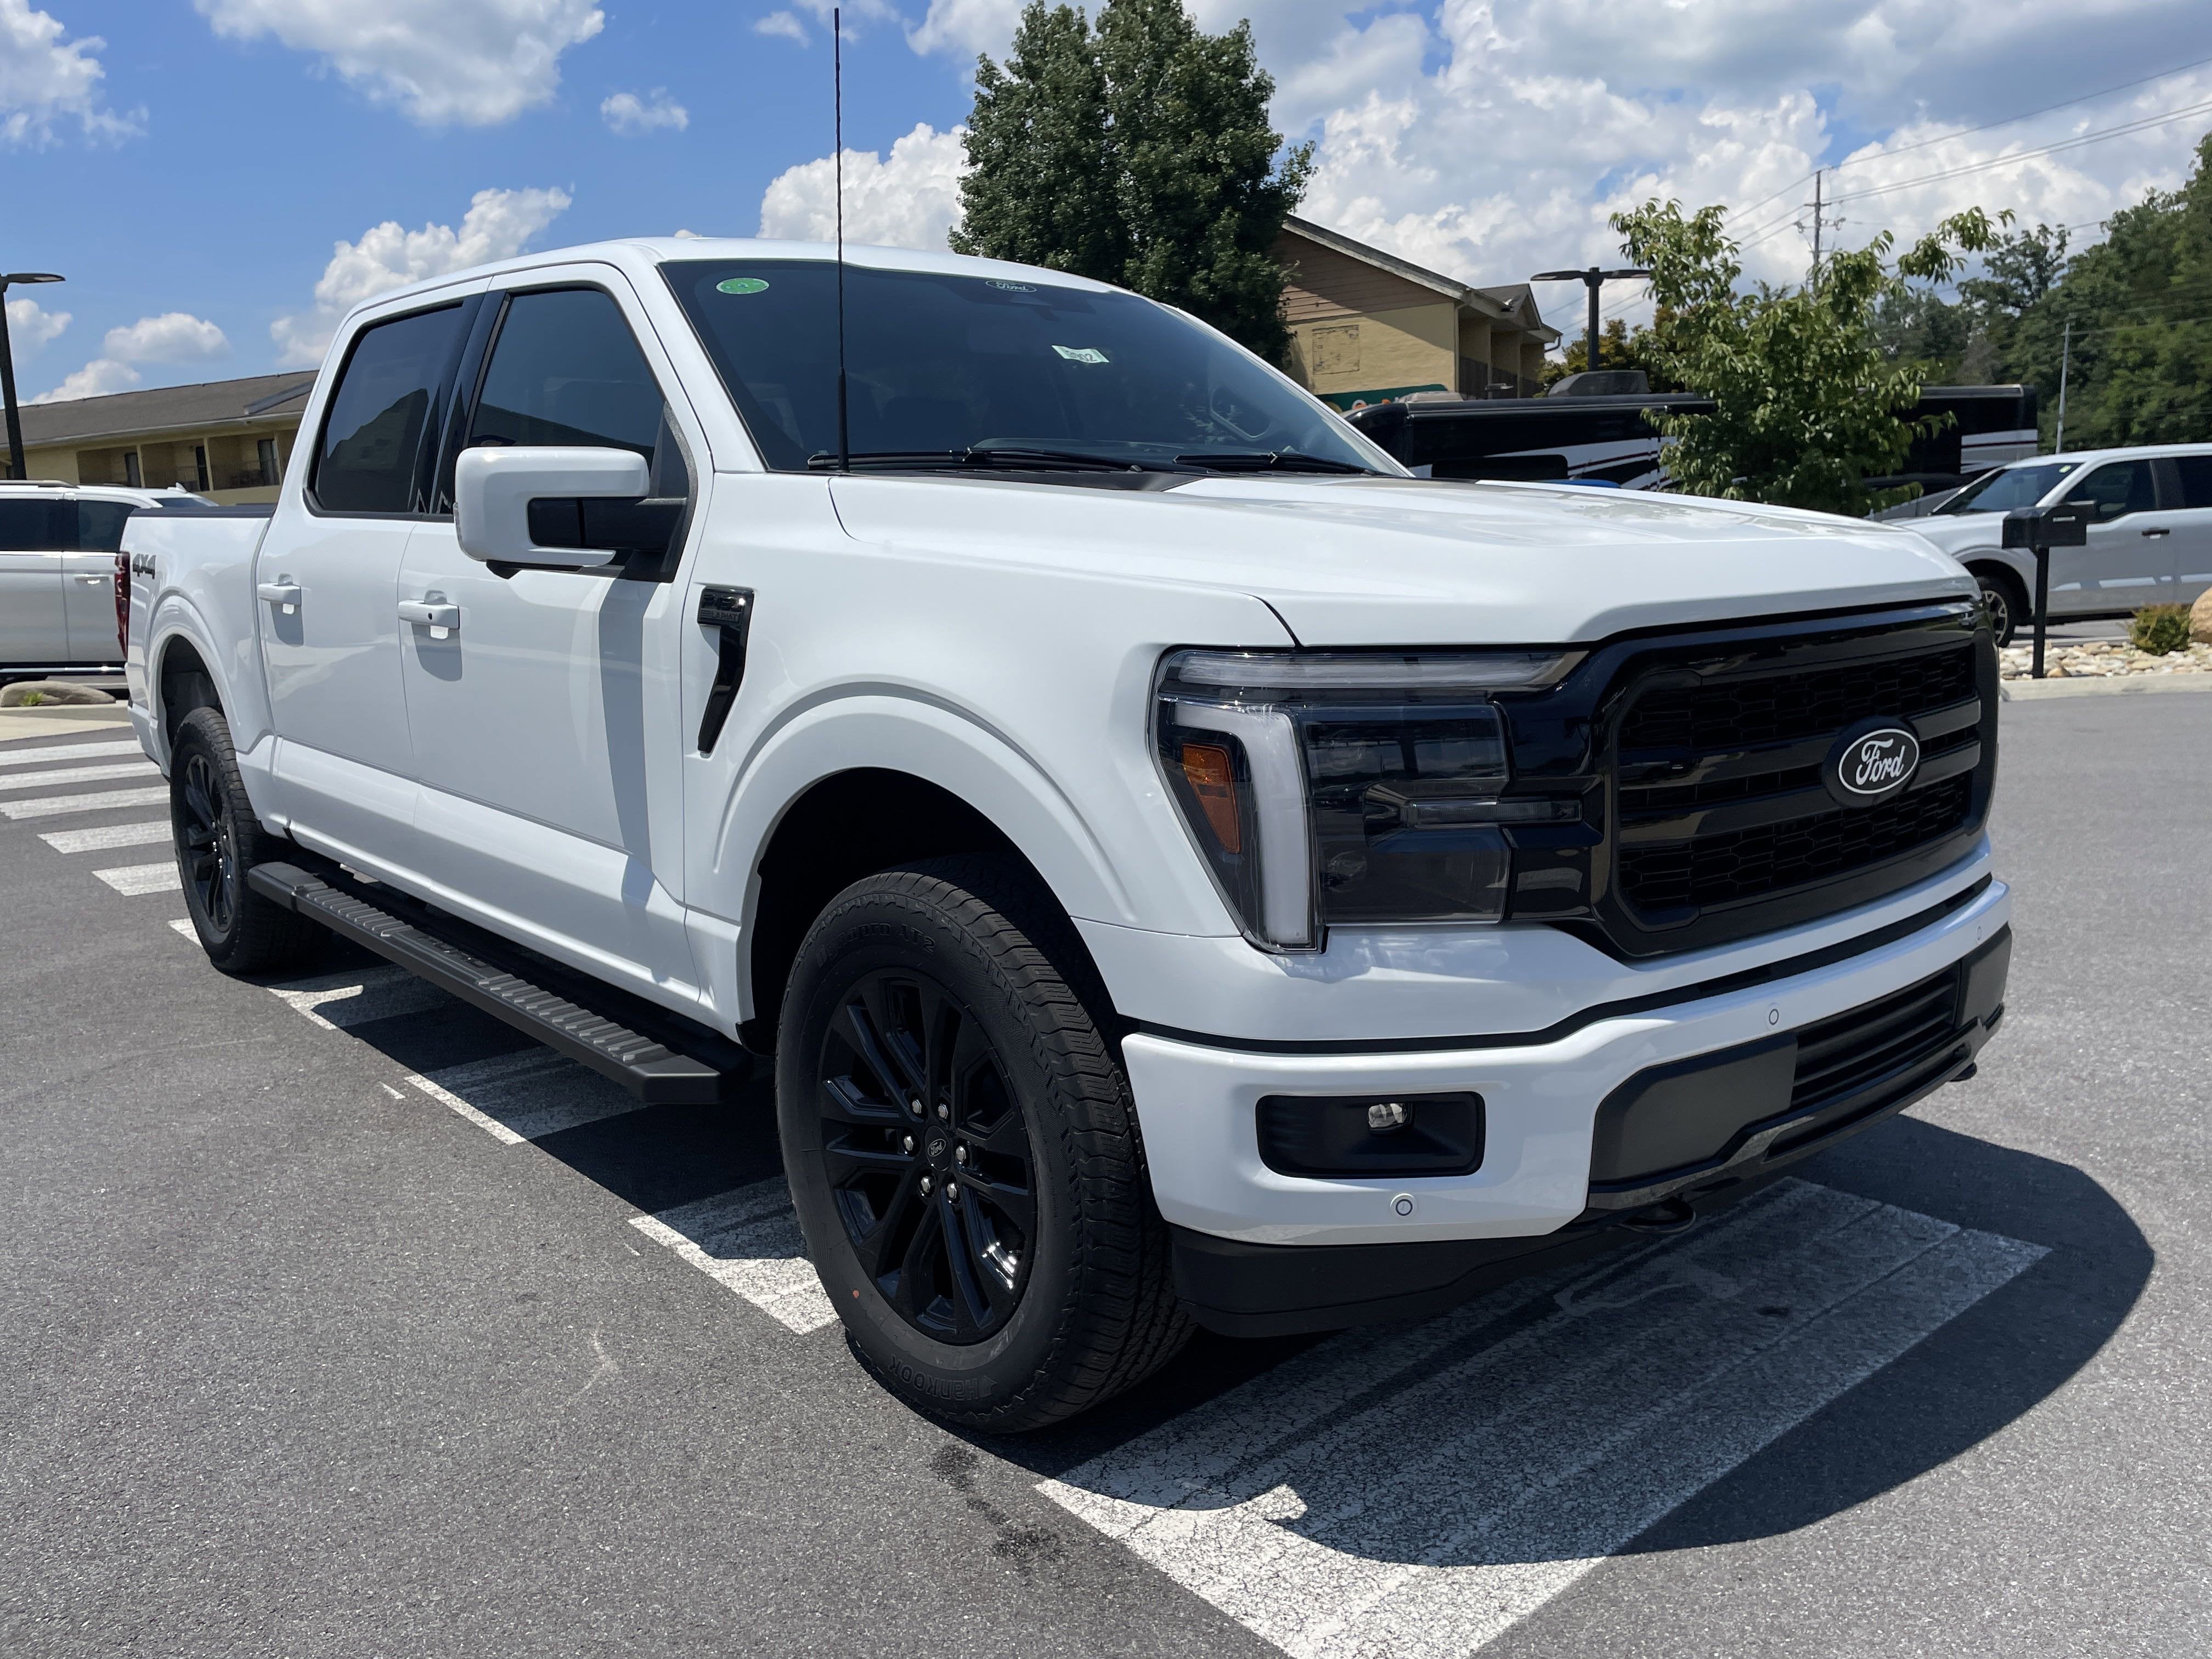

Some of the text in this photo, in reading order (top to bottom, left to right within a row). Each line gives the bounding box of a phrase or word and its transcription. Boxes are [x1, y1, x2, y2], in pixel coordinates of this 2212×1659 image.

[996, 281, 1029, 290] Ford
[711, 611, 738, 621] LARIAT
[1856, 738, 1905, 785] Ford
[930, 1141, 943, 1155] Ford
